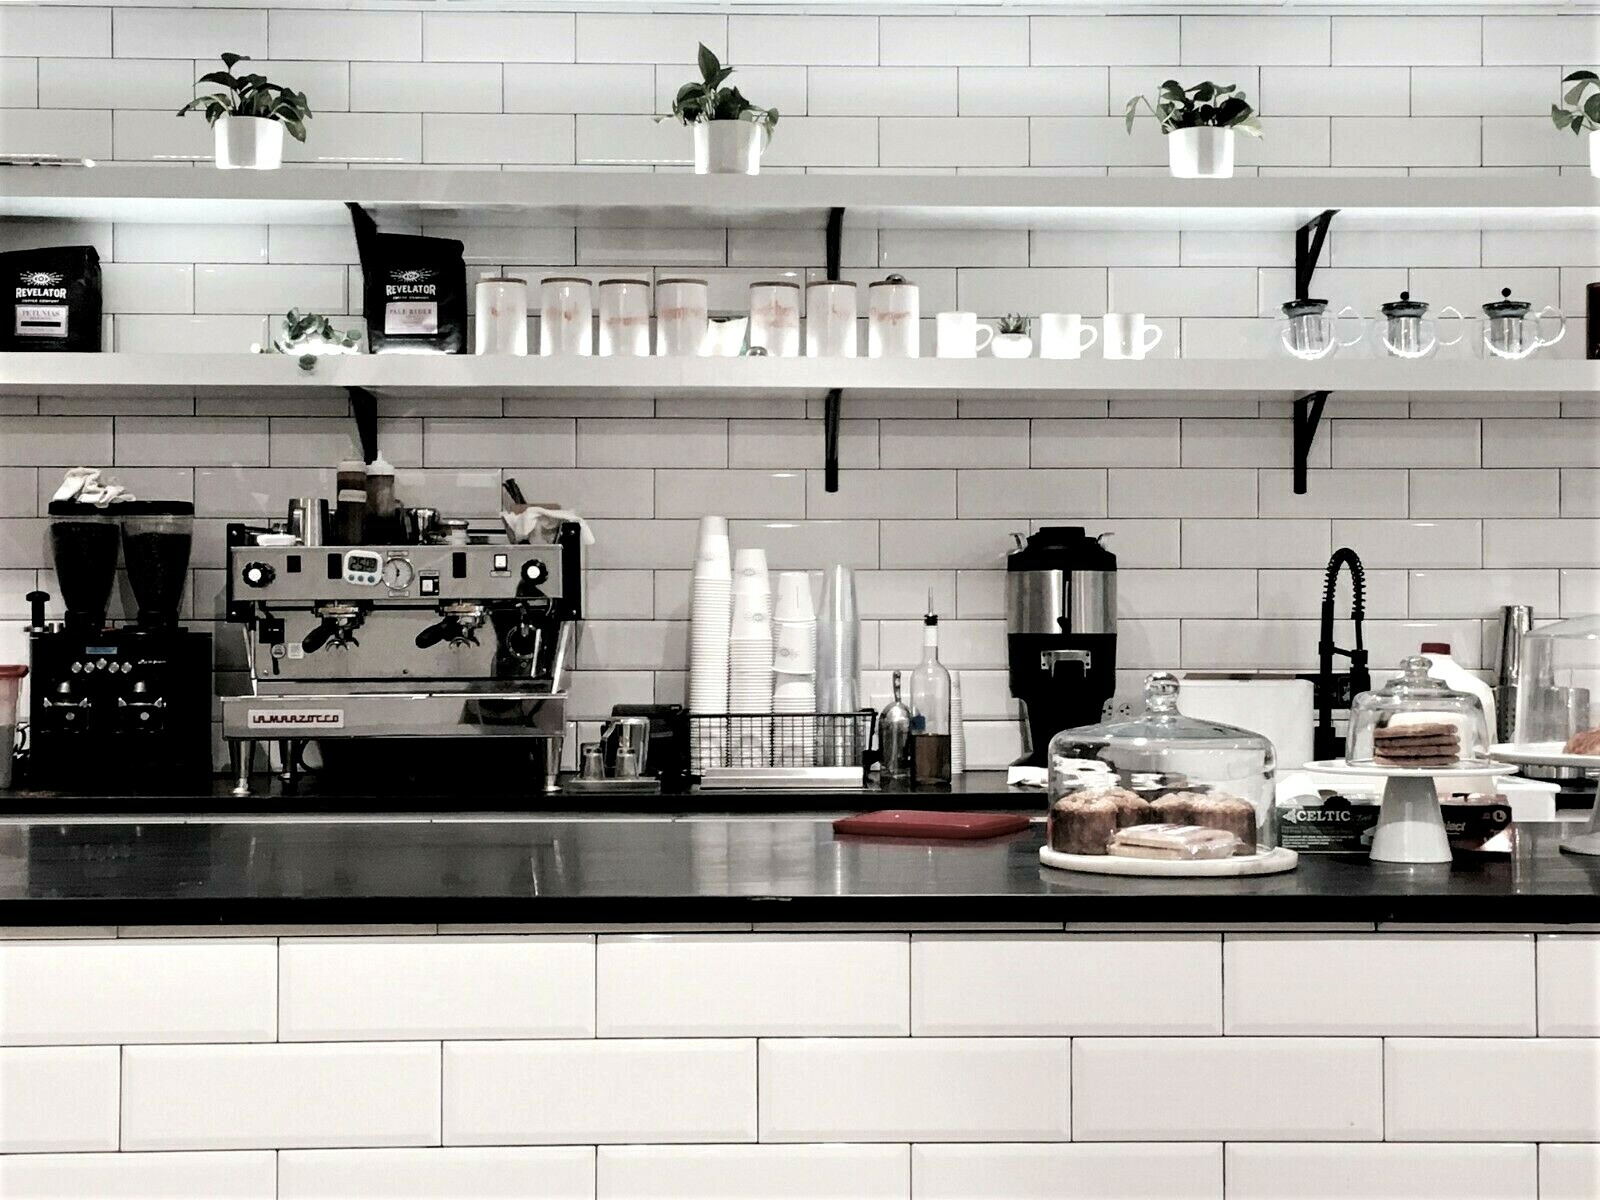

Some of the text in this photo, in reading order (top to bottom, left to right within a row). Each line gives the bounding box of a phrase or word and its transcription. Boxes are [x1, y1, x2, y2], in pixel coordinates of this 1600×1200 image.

[15, 287, 67, 299] REVELATOR
[385, 284, 436, 296] REVELATOR
[1296, 810, 1351, 822] CELTIC
